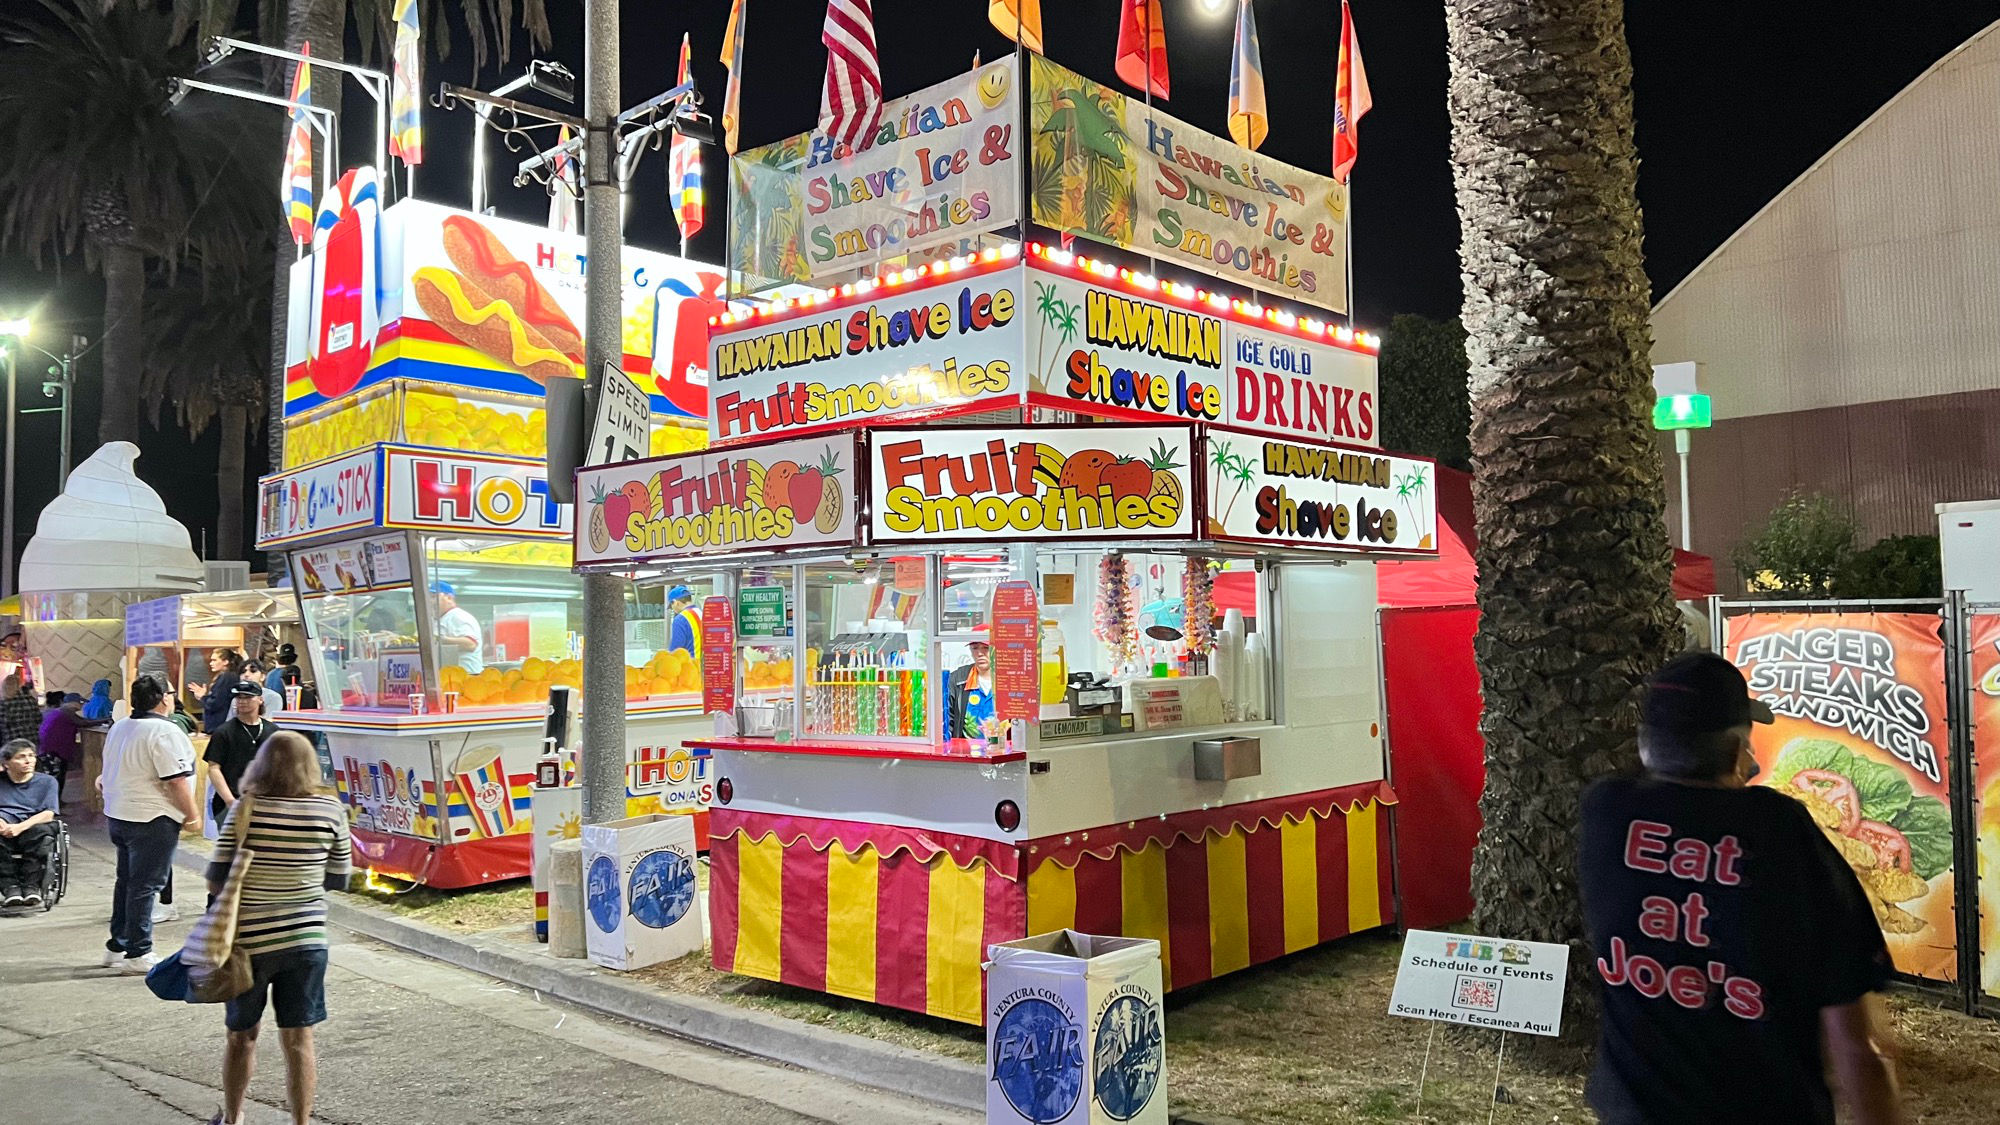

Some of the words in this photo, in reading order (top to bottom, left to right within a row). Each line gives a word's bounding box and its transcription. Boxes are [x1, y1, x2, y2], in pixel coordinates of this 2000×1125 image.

[807, 166, 910, 217] Shave
[915, 147, 970, 187] Ice
[978, 123, 1012, 166] &
[1144, 118, 1306, 206] Hawaiian
[810, 191, 991, 264] Smoothies
[1155, 162, 1259, 228] Shave
[1263, 201, 1305, 246] Ice
[1310, 222, 1335, 257] &
[1152, 208, 1317, 293] Smoothies
[716, 319, 842, 380] HAWAIIAN
[847, 302, 951, 355] Shave
[958, 287, 1015, 334] Ice
[1085, 289, 1222, 369] HAWAIIAN
[1235, 333, 1264, 367] ICE
[1268, 344, 1312, 376] COLD
[607, 376, 648, 421] SPEED
[715, 381, 809, 438] Fruit
[1066, 349, 1171, 412] Shave
[1176, 369, 1221, 420] Ice
[1235, 366, 1373, 441] DRINKS
[607, 404, 645, 445] LIMIT
[411, 459, 561, 528] HOT
[659, 457, 752, 517] Fruit
[880, 438, 1041, 498] Fruit
[1262, 441, 1391, 489] HAWAIIAN
[288, 478, 318, 534] DOG
[336, 462, 373, 517] STICK
[625, 501, 794, 553] Smoothies
[884, 483, 1180, 534] Smoothies
[1255, 484, 1351, 540] Shave
[1356, 497, 1399, 544] Ice
[742, 593, 755, 602] STAY
[756, 592, 780, 602] HEALTHY
[1735, 627, 1895, 677] FINGER
[1747, 661, 1930, 734] STEAKS
[1053, 720, 1089, 736] LEMONADE
[343, 756, 381, 801] HOT
[379, 759, 421, 806] DOG
[634, 747, 712, 787] HOT
[669, 792, 687, 802] ON
[688, 791, 697, 801] A
[1624, 819, 1743, 886] Eat
[629, 854, 694, 912] FAIR
[1638, 892, 1710, 947] at
[1411, 956, 1478, 973] Schedule
[1483, 965, 1498, 975] of
[1503, 966, 1554, 982] Events
[1597, 936, 1765, 1020] Joe's
[993, 987, 1036, 1018] VENTURA
[1037, 987, 1076, 1021] COUNTY
[1091, 987, 1119, 1033] VENTURA
[1120, 983, 1154, 1004] COUNTY
[1396, 1003, 1425, 1016] Scan
[1429, 1008, 1458, 1021] Here
[1460, 1012, 1466, 1021] /
[1468, 1014, 1520, 1029] Escanea
[1523, 1020, 1552, 1033] Aquí
[994, 1022, 1084, 1080] FAIR
